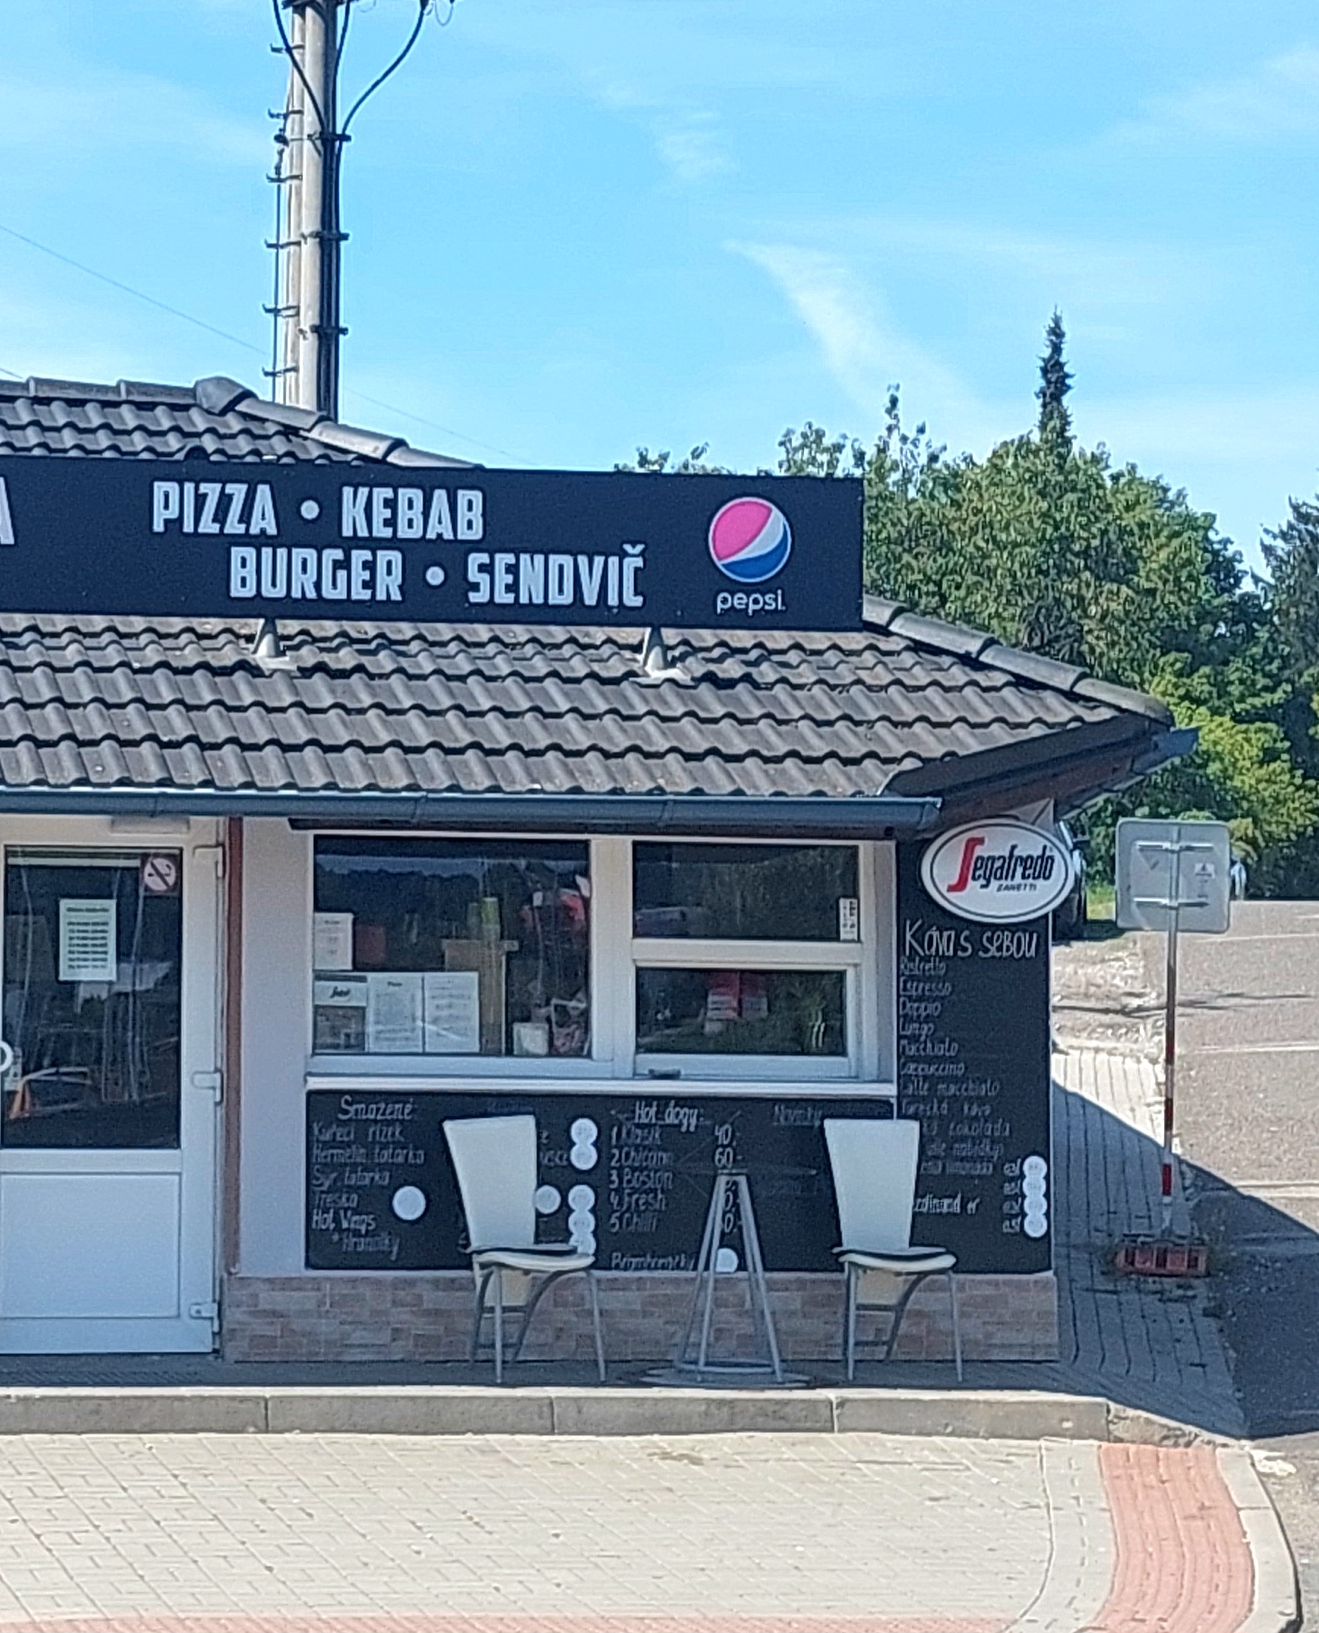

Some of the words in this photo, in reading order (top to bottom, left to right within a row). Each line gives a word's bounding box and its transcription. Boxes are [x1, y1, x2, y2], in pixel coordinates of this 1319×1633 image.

[152, 480, 278, 537] PIZZA
[341, 485, 484, 541] KEBAB
[229, 546, 403, 601] BURGER
[467, 543, 646, 608] SENDVIČ
[716, 588, 783, 616] pepsi
[946, 836, 1055, 893] Segafredo
[634, 1100, 658, 1123] Hot
